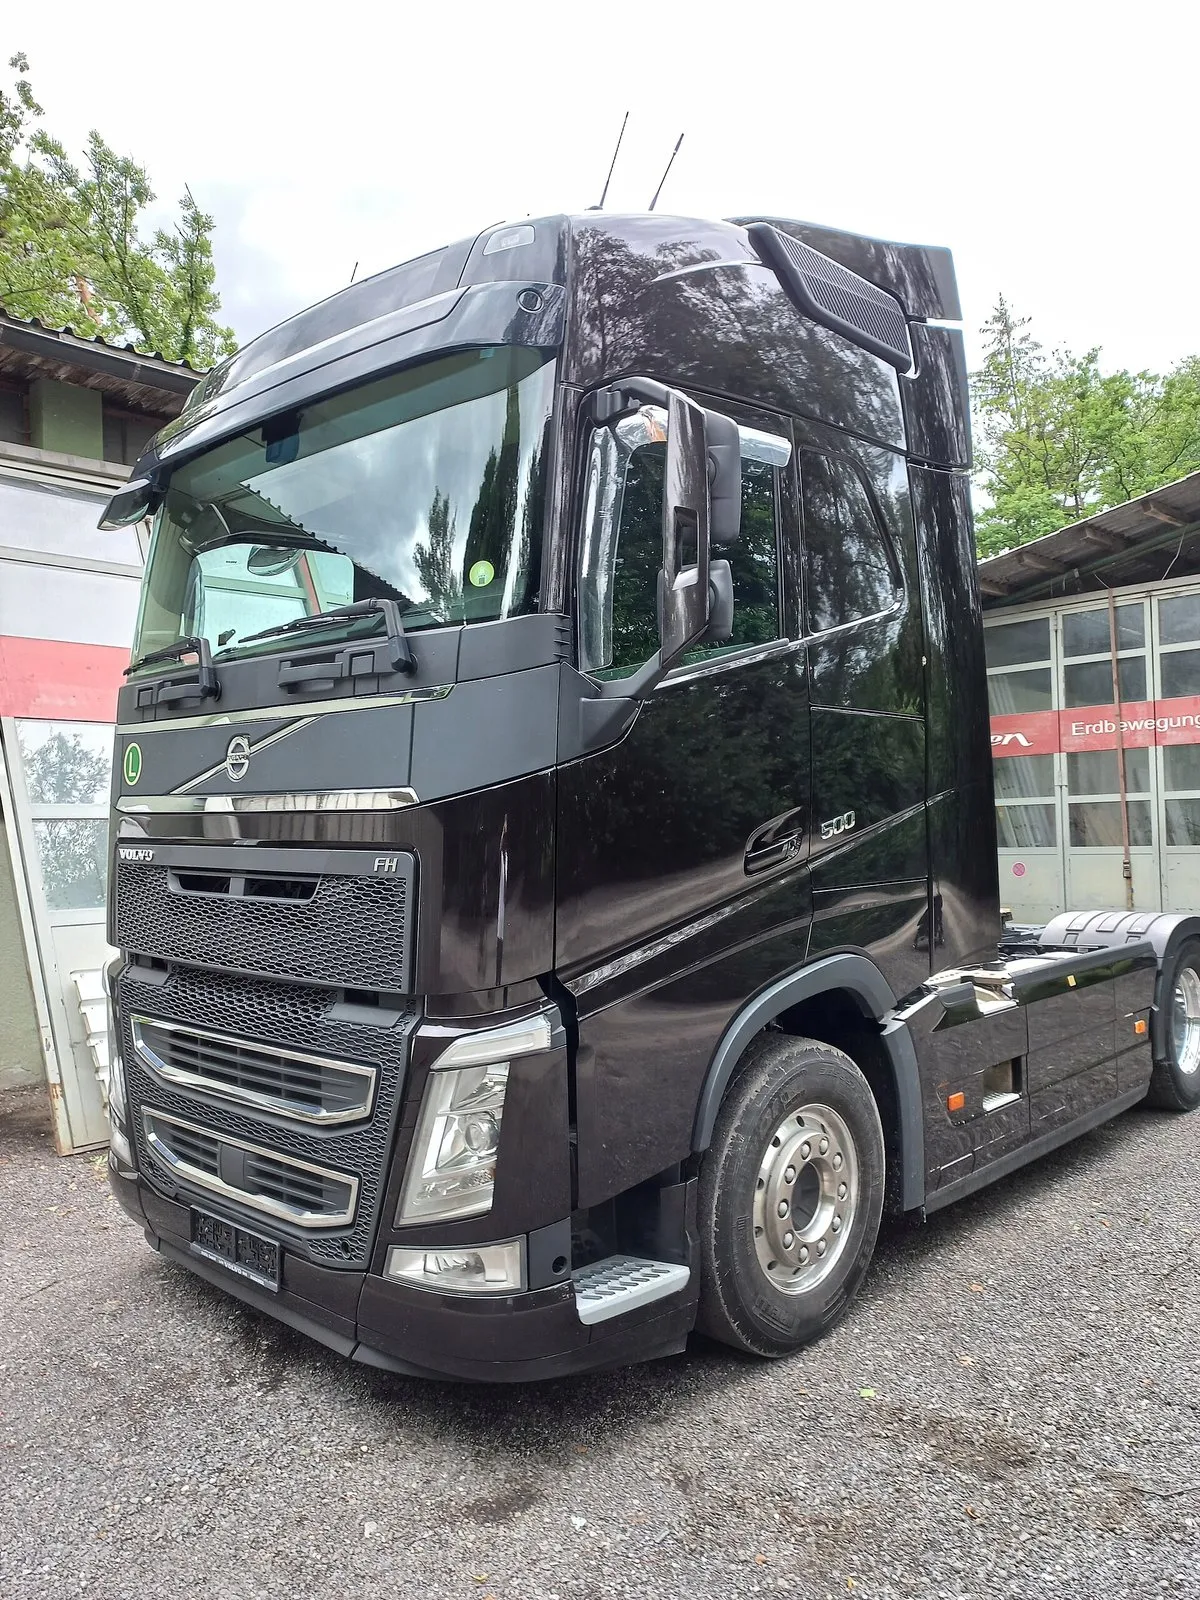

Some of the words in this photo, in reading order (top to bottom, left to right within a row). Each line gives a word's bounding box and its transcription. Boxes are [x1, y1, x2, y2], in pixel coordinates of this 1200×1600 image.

[129, 751, 137, 777] L
[820, 810, 856, 840] 500
[118, 848, 154, 862] VOLVO
[373, 857, 399, 872] FH
